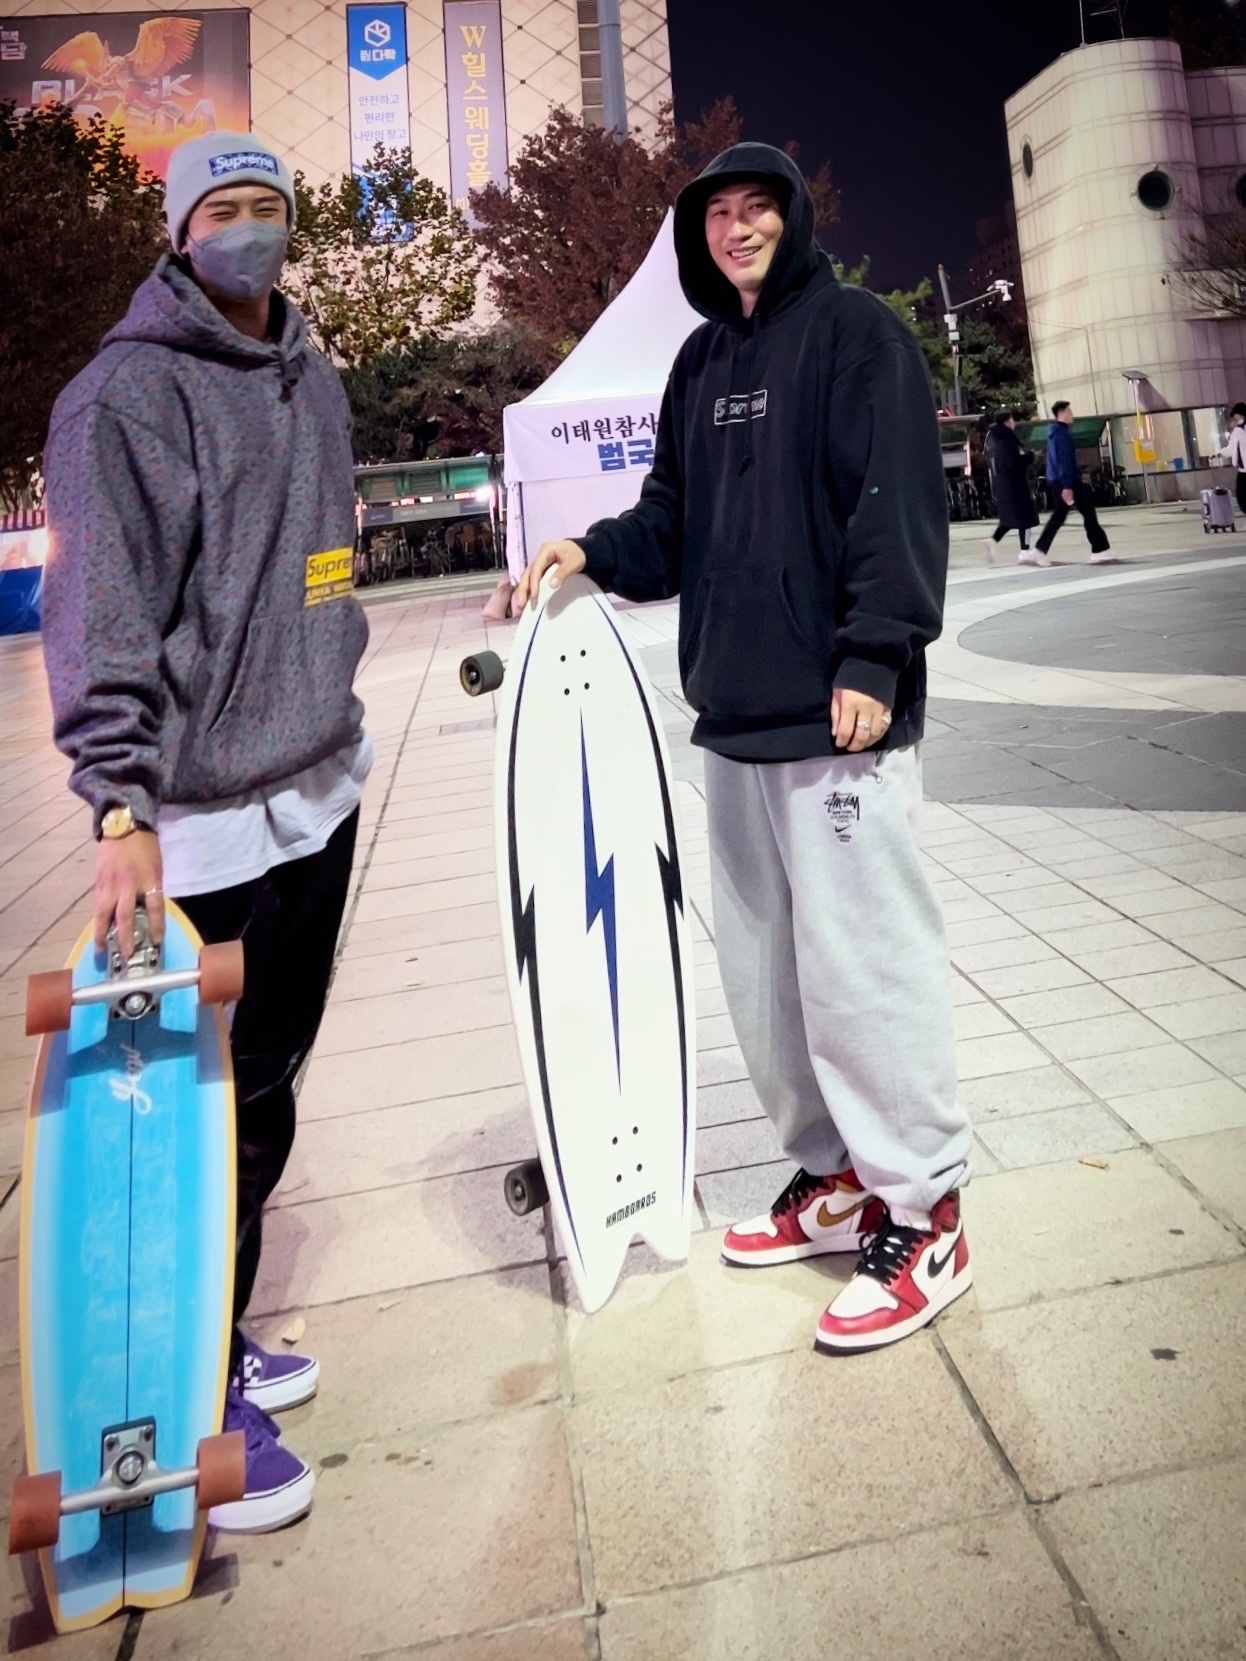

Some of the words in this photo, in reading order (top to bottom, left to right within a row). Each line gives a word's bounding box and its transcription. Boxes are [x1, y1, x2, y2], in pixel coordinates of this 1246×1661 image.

[358, 94, 400, 107] 안전하고
[364, 111, 395, 124] 편리한
[551, 412, 657, 445] 이태원참사
[597, 438, 655, 472] 범국
[605, 1190, 657, 1229] HAMBOARDS
